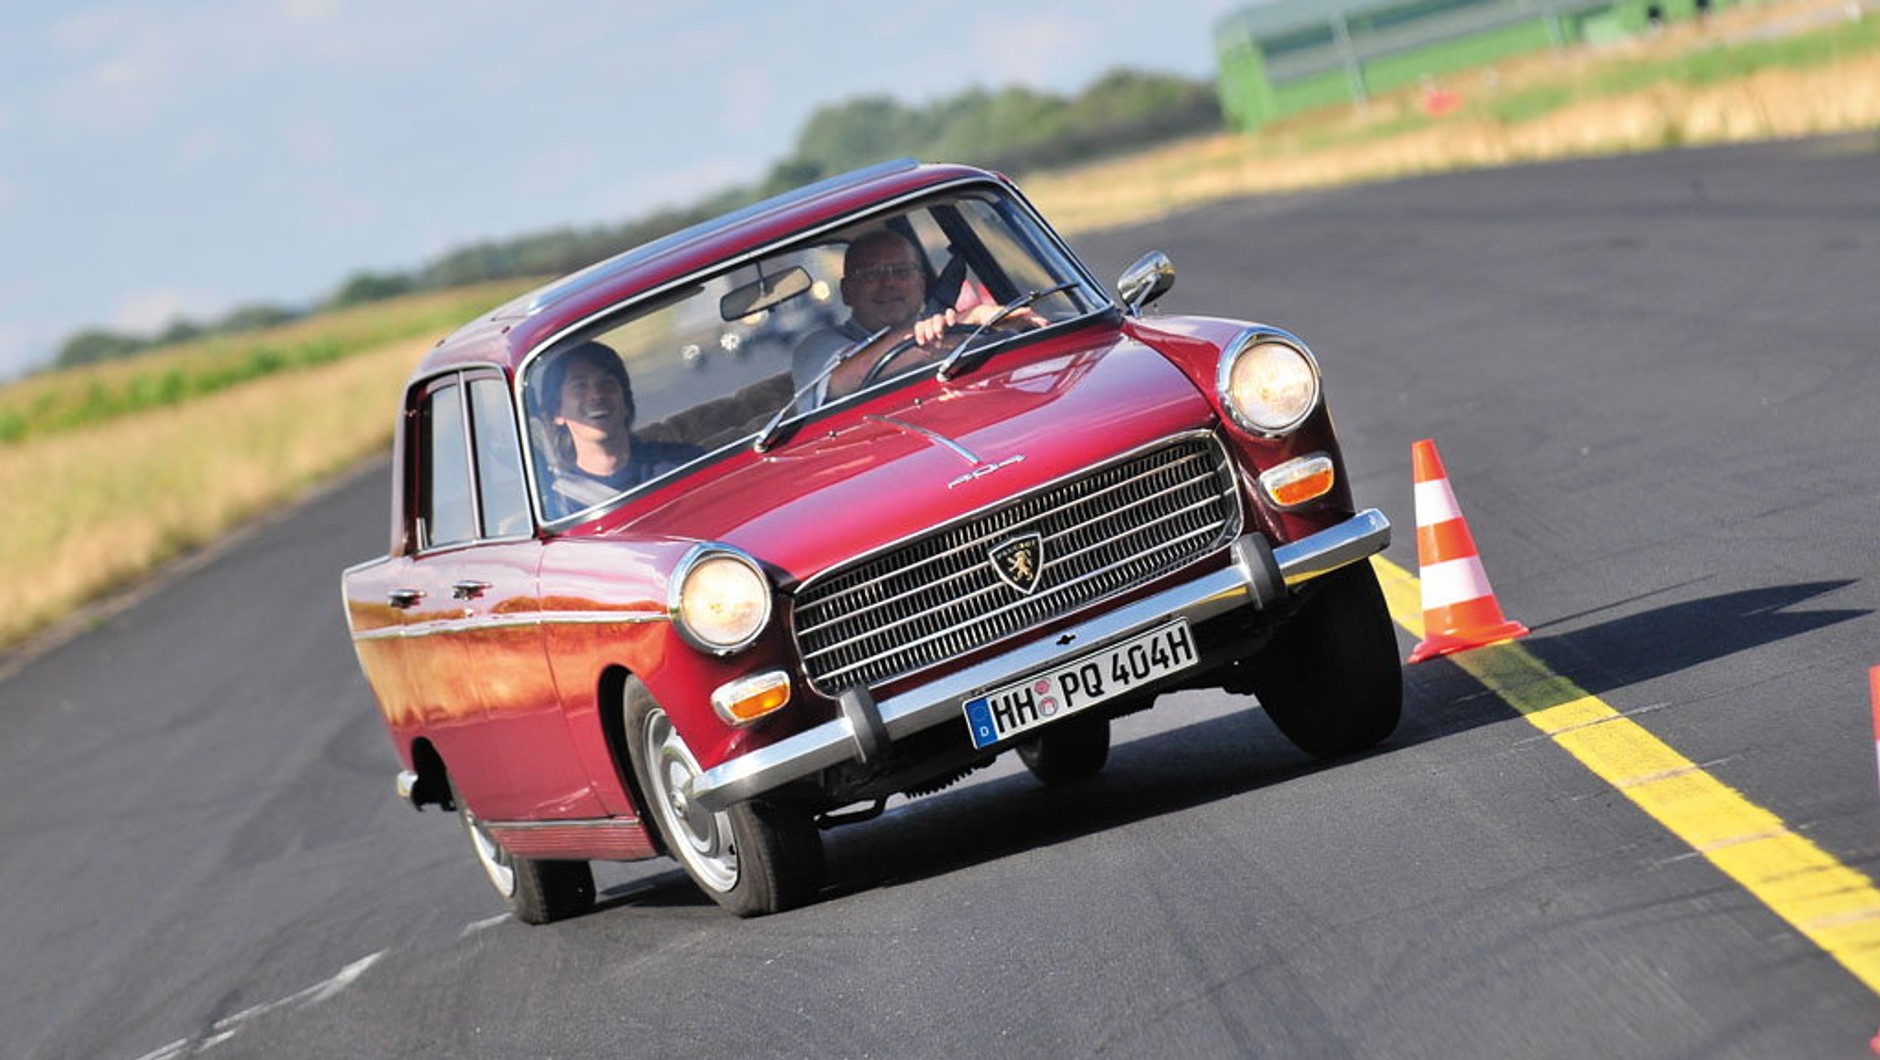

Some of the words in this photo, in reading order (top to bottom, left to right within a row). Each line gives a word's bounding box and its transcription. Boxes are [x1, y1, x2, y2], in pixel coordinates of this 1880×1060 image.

[991, 688, 1038, 733] HH
[1058, 663, 1105, 707] PQ
[1112, 626, 1193, 685] 404H
[980, 726, 989, 737] D
